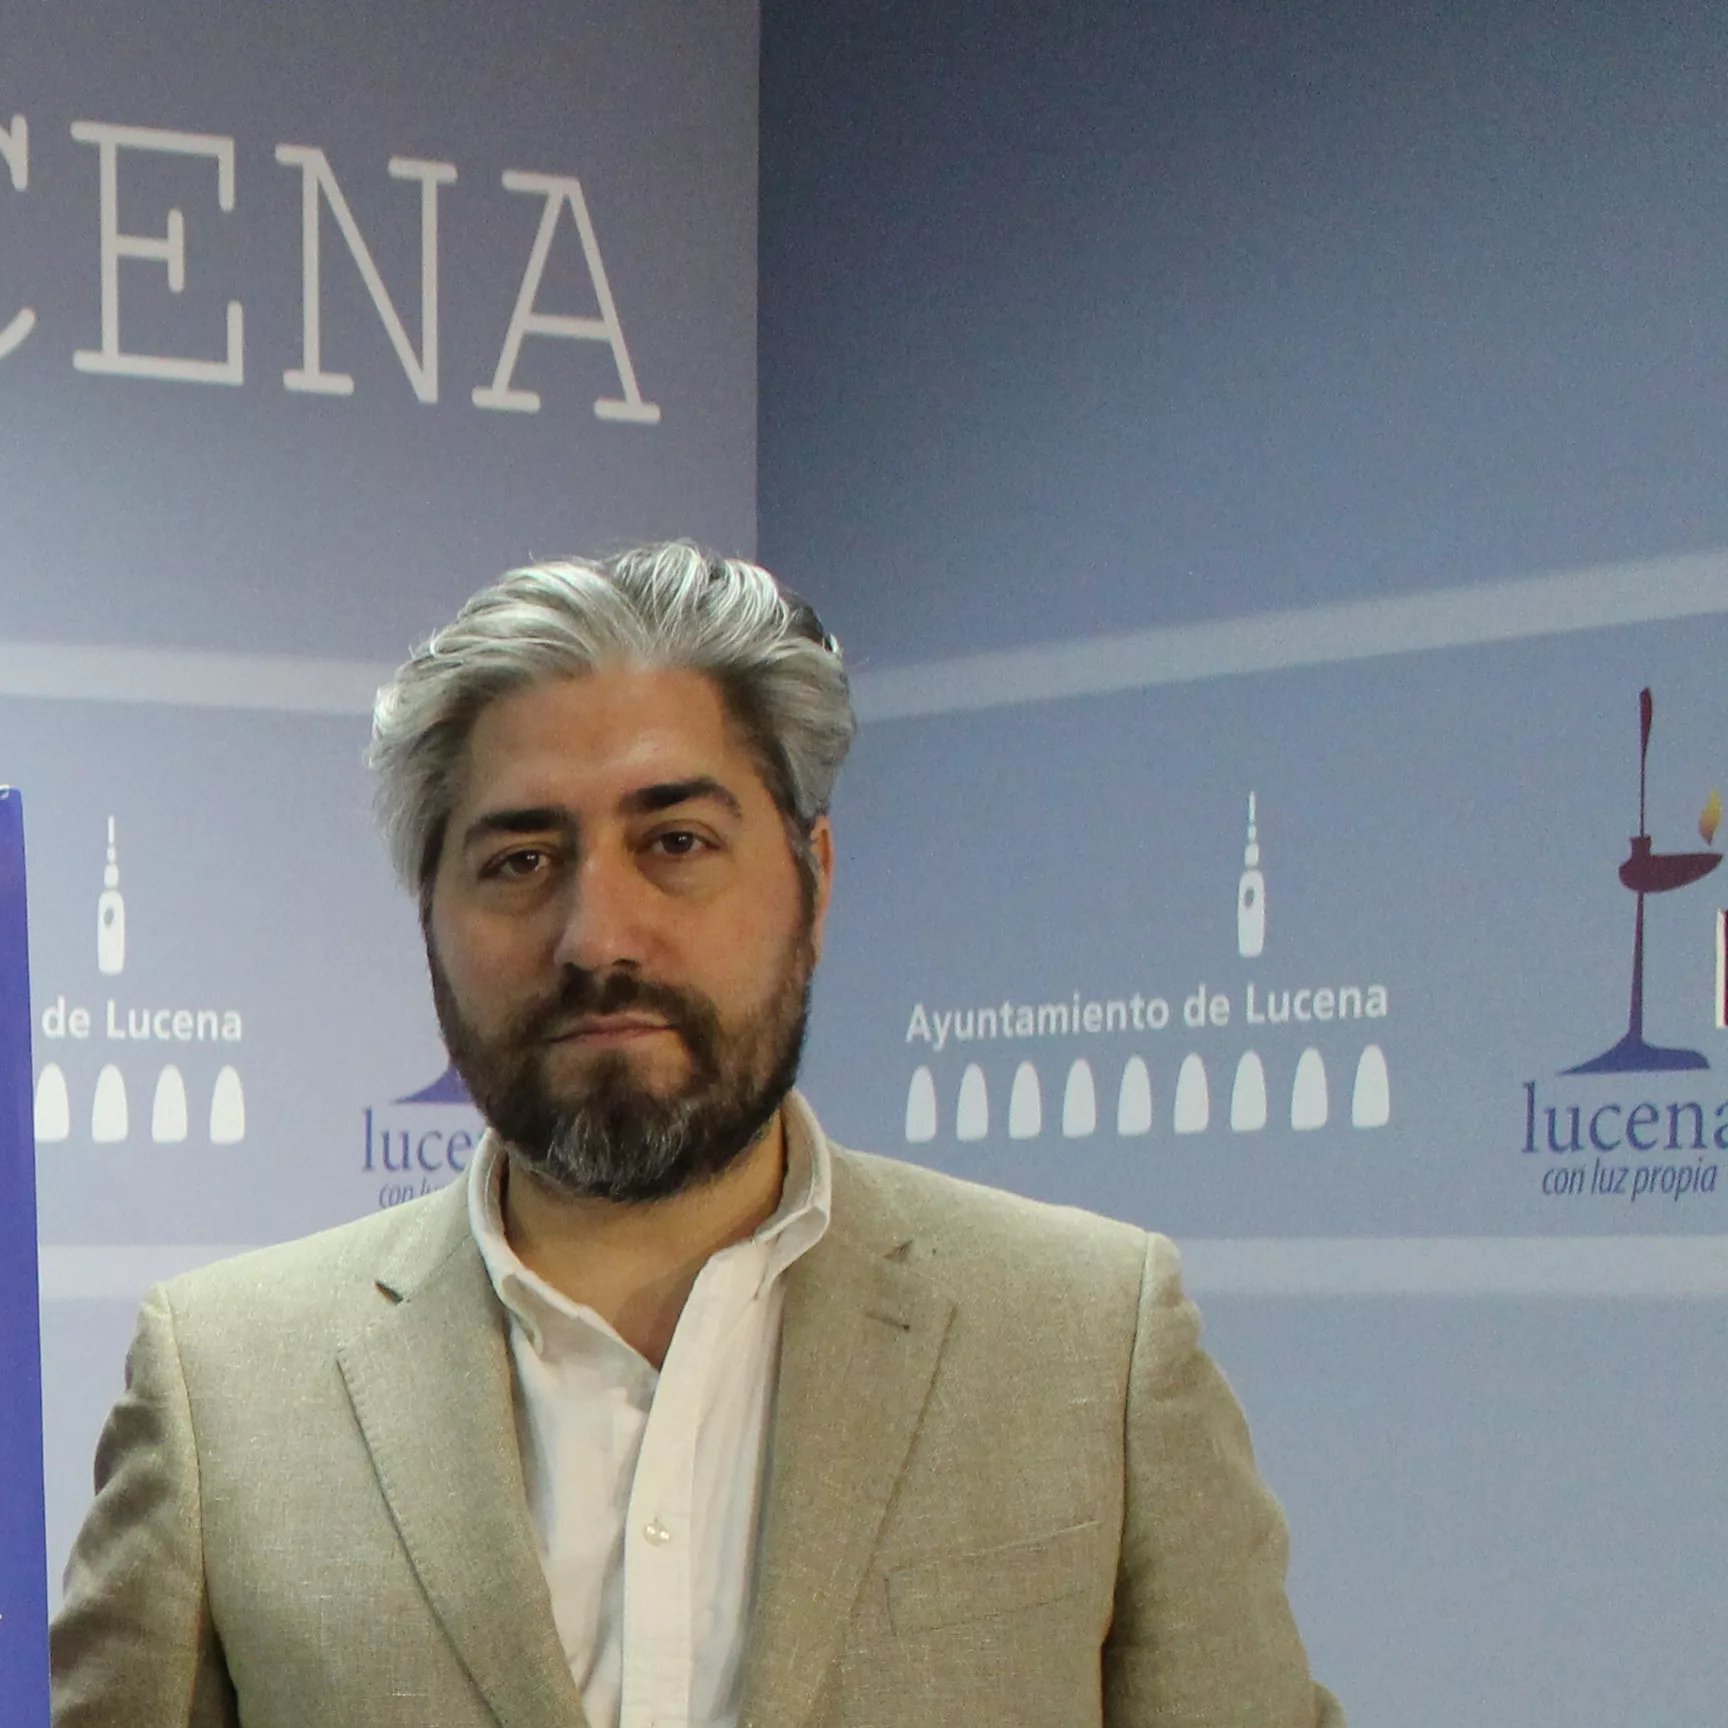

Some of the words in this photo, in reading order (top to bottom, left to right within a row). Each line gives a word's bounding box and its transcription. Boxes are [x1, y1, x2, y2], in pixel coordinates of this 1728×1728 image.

[41, 995, 90, 1038] de
[106, 999, 242, 1040] Lucena
[905, 992, 1169, 1050] Ayuntamiento
[1183, 983, 1230, 1027] de
[1246, 983, 1388, 1023] Lucena
[1542, 1163, 1585, 1196] con
[1591, 1157, 1629, 1195] luz
[1631, 1156, 1718, 1202] propia
